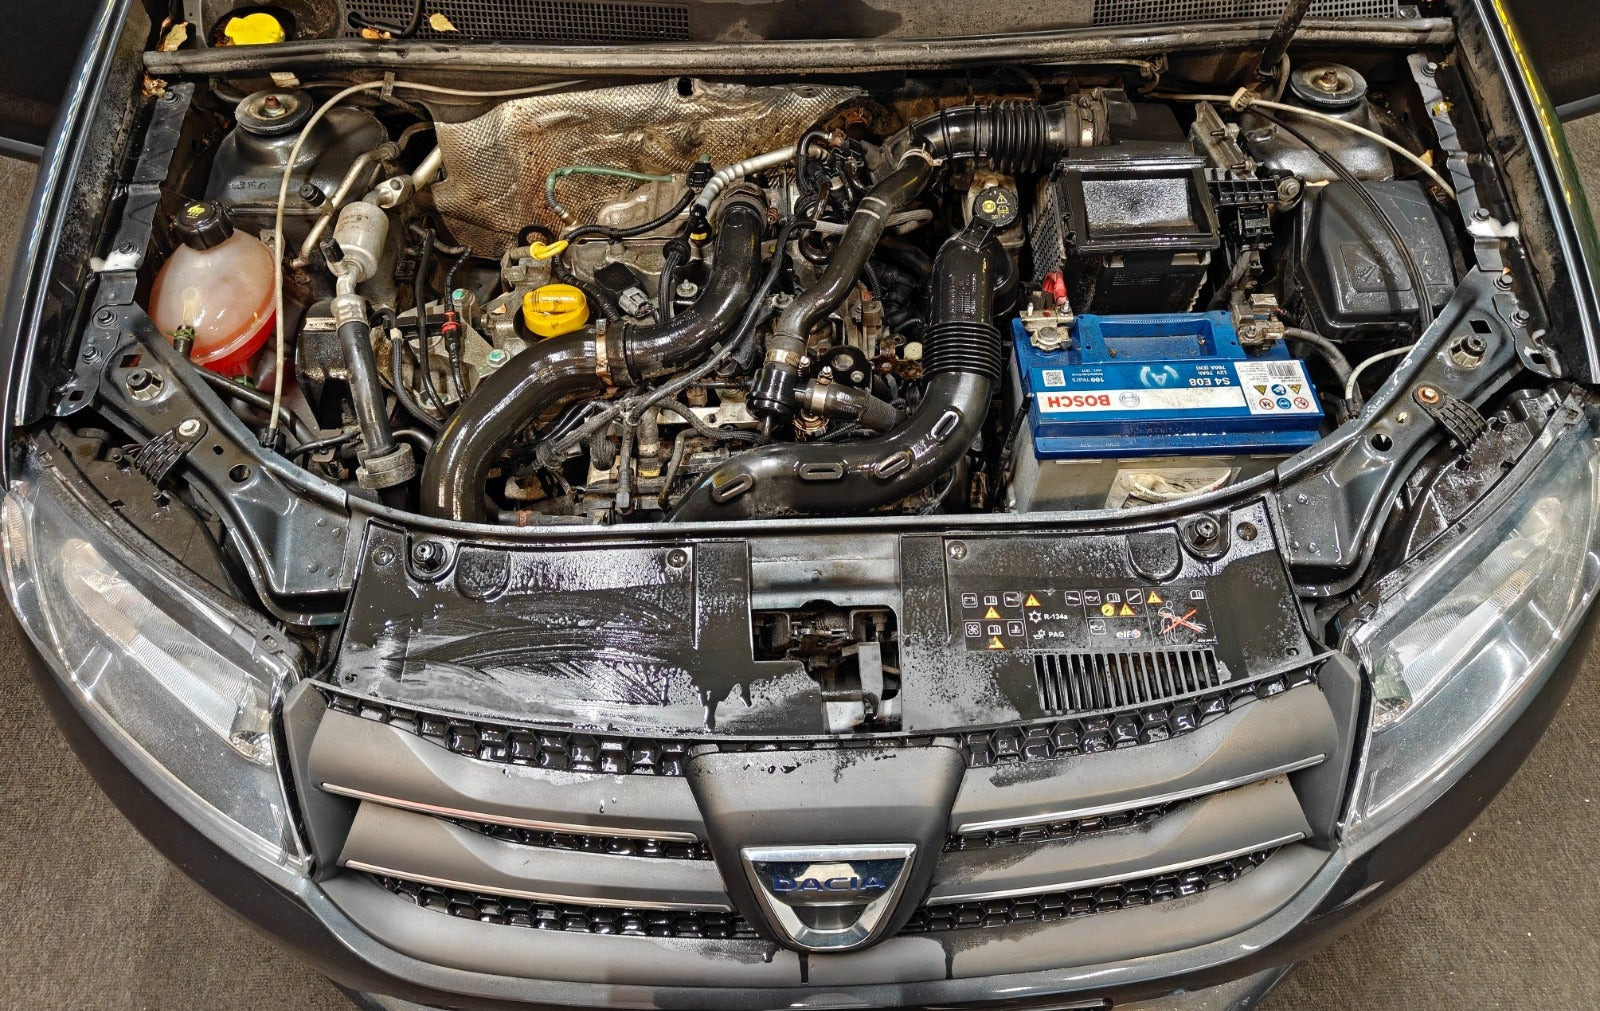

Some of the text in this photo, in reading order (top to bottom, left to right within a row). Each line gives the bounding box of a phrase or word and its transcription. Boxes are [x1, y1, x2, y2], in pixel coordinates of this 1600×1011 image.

[1188, 377, 1231, 386] S4 E08
[1047, 394, 1111, 408] BOSCH
[772, 876, 887, 892] DACIA
